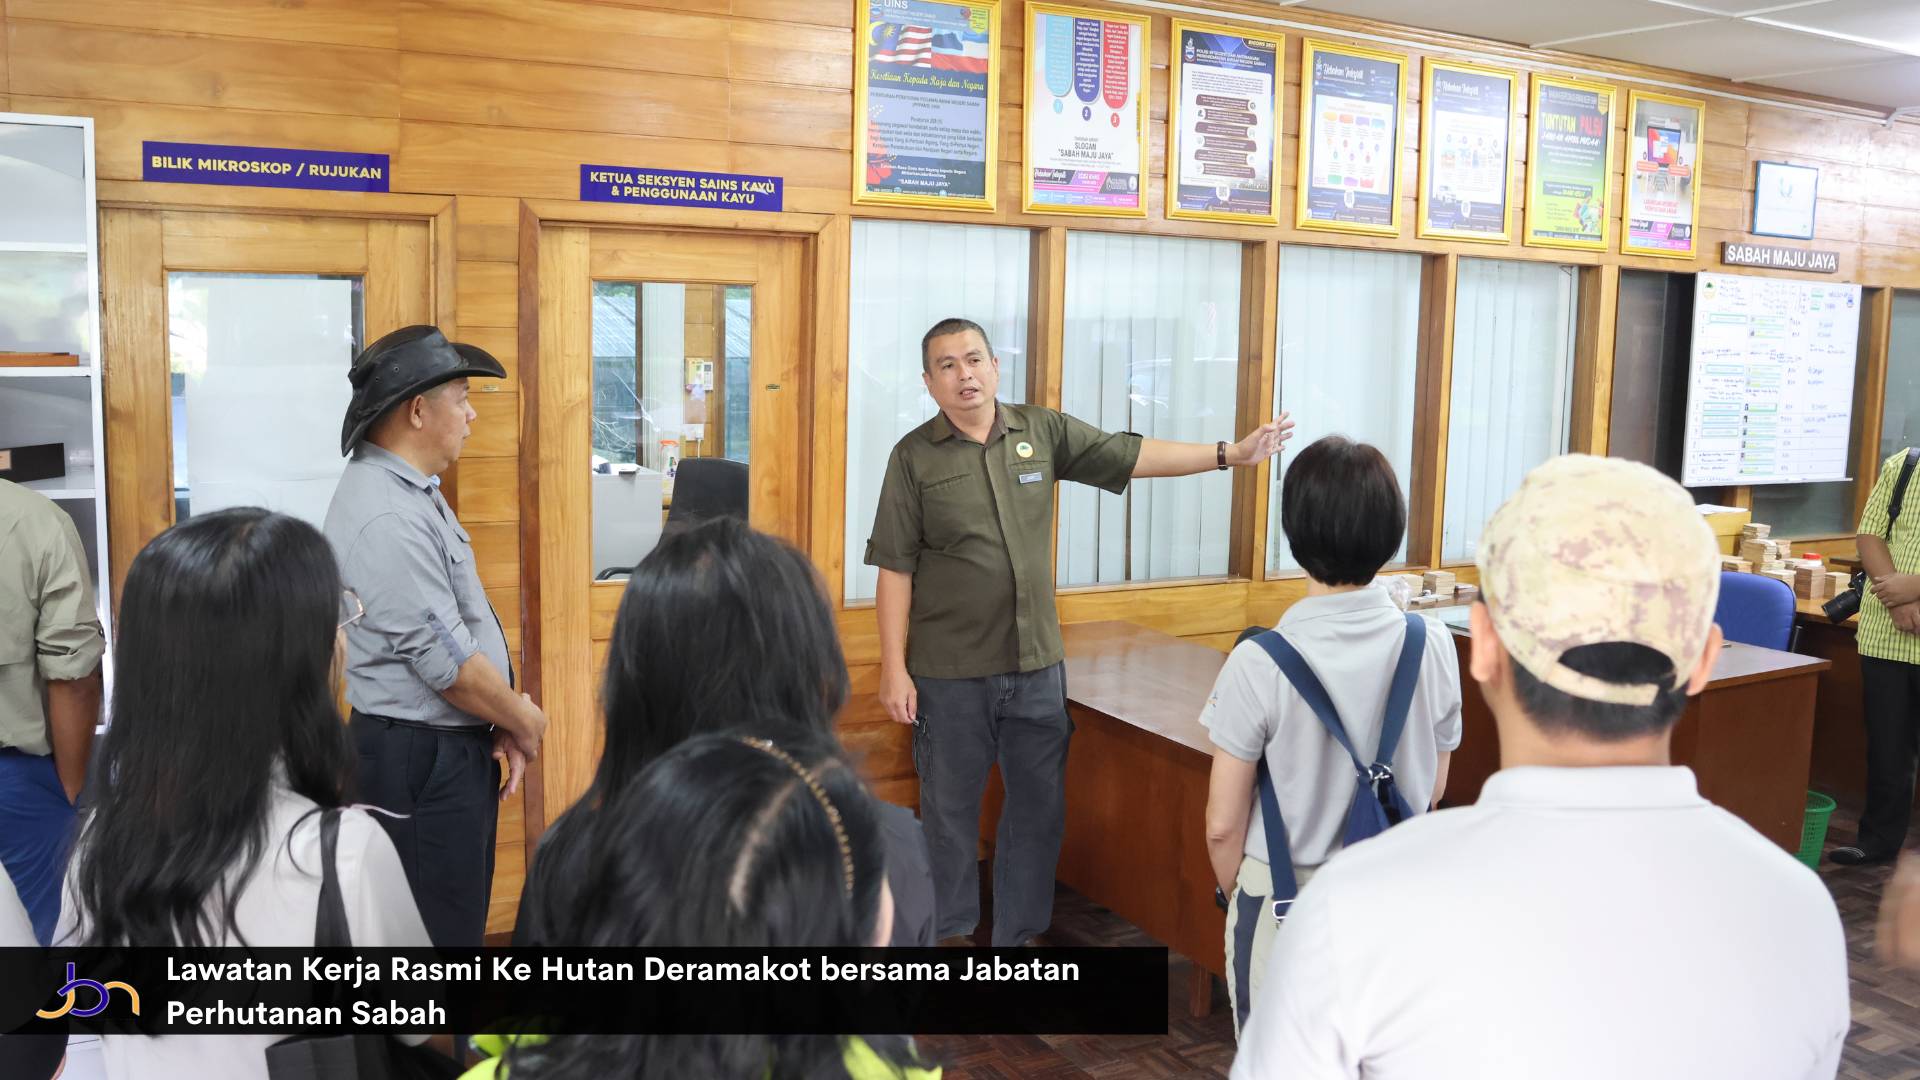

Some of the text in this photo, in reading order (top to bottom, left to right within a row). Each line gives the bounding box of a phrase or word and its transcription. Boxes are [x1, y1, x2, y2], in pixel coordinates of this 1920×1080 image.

[870, 69, 984, 92] Kesetiaan Kepada Raja dan Negara
[1542, 112, 1576, 133] TUNTUTAN
[1075, 142, 1096, 150] SLOGAN
[152, 156, 381, 179] BILIK MIKROSKOP / RUJUKAN
[590, 172, 775, 194] KETUA SEKSYEN SAINS KAYU
[611, 186, 755, 204] & PENGGUNAAN KAYU
[1728, 245, 1836, 269] SABAH MAJU JAYA
